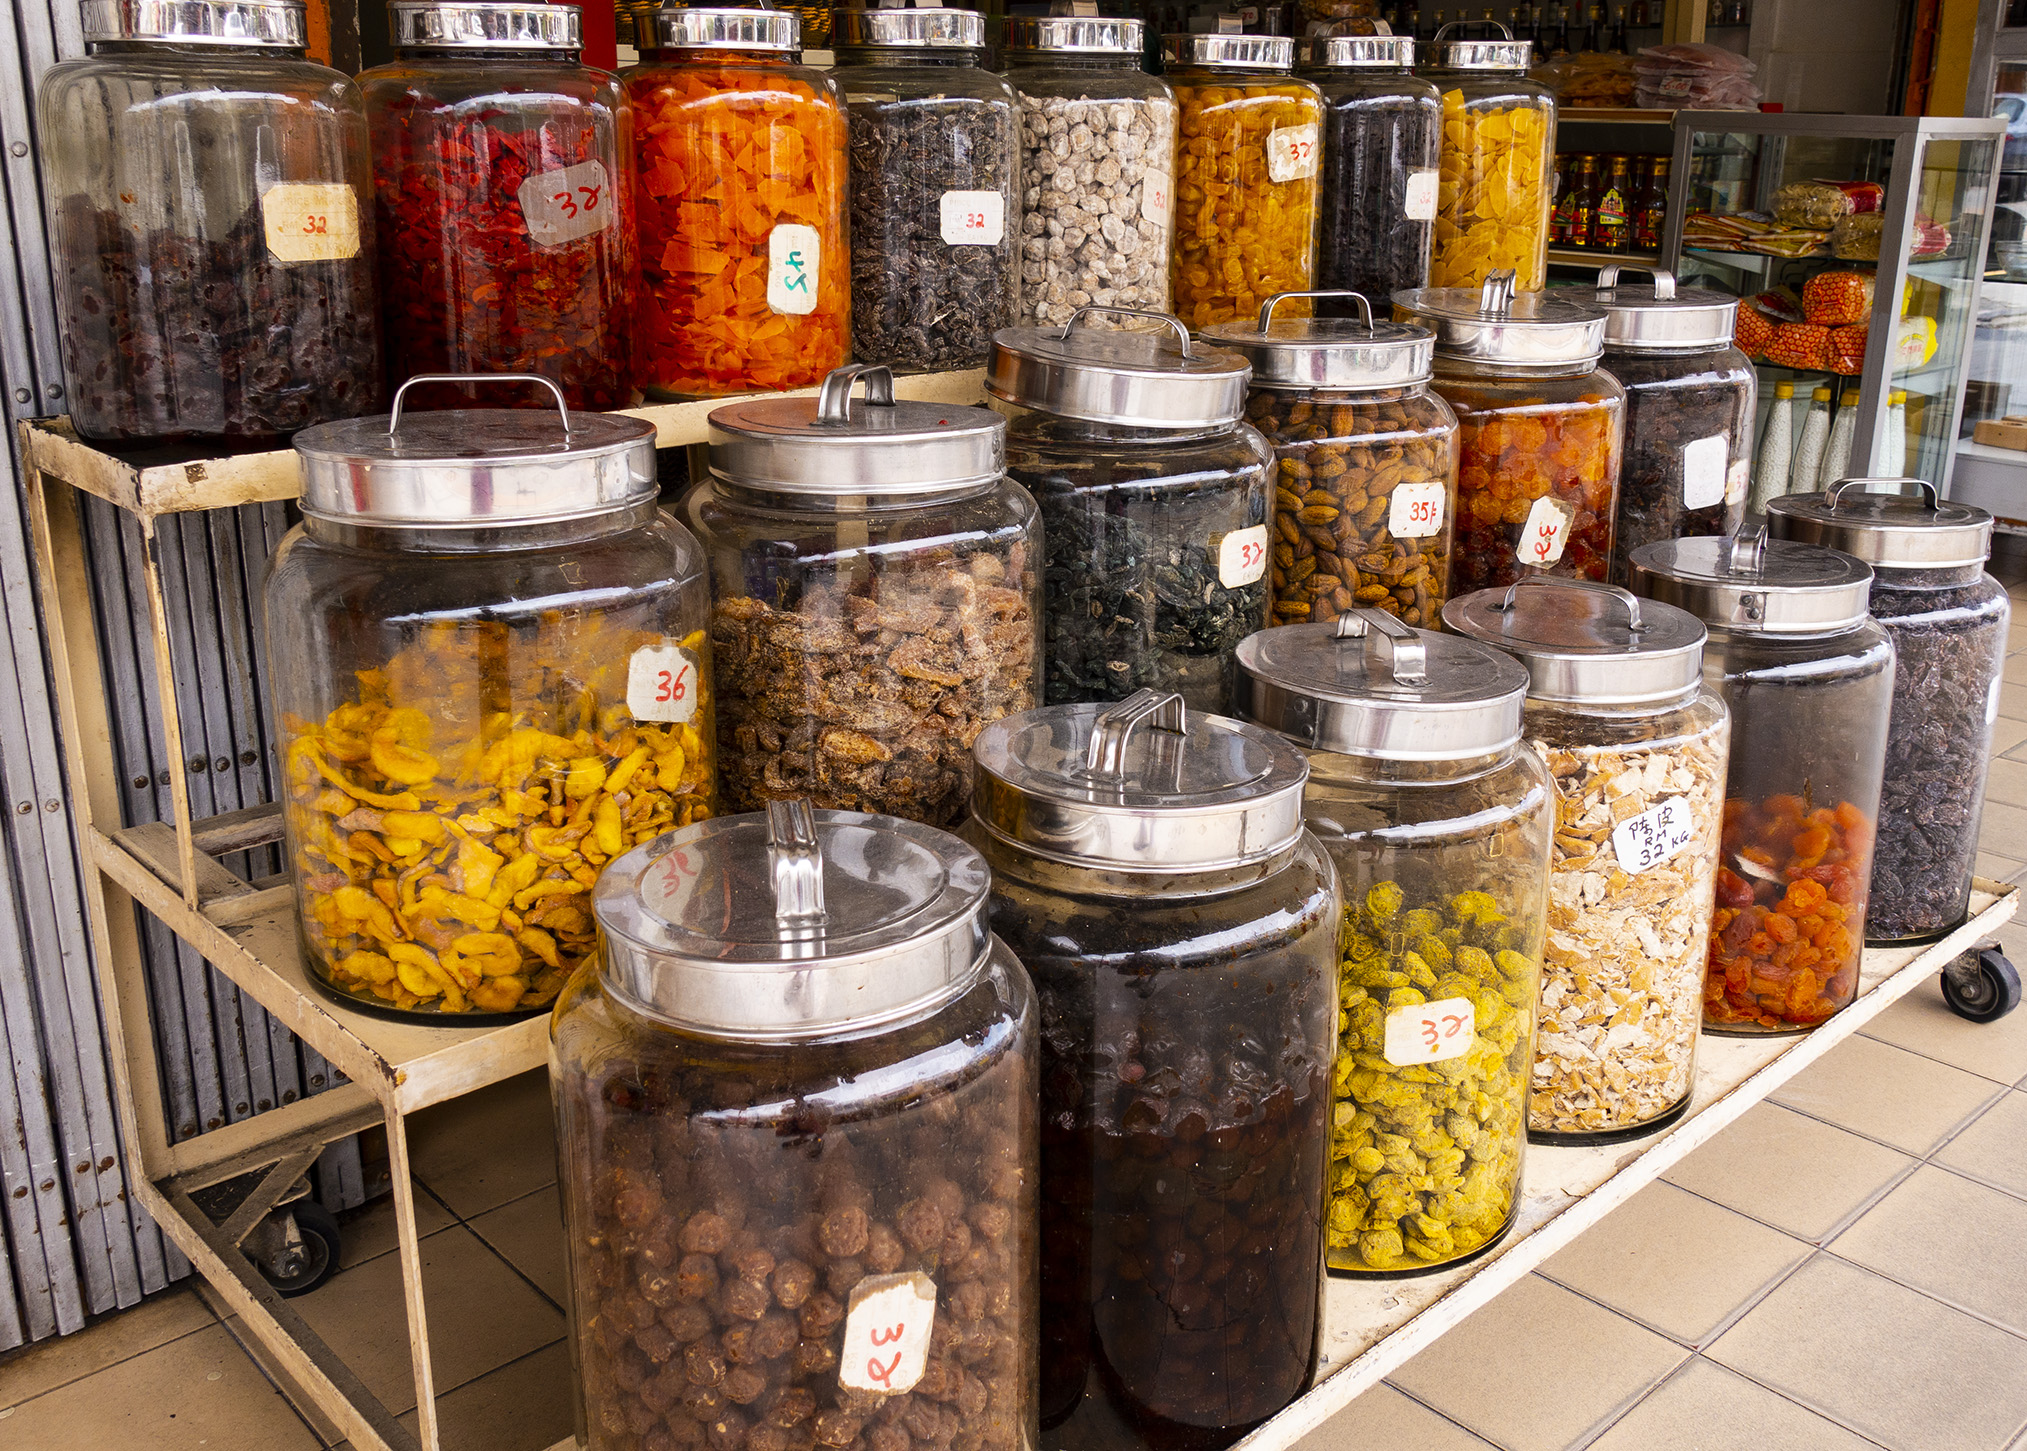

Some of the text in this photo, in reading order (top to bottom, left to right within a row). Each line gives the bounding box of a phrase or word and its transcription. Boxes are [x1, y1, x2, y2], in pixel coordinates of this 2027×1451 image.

[1290, 142, 1315, 160] 32
[553, 184, 601, 220] 32
[303, 215, 327, 234] 32
[965, 213, 985, 229] 32
[783, 250, 809, 295] 45
[1241, 541, 1264, 569] 32
[1535, 524, 1558, 560] 32
[656, 664, 689, 703] 36
[1639, 830, 1690, 866] 32 KG
[1644, 829, 1667, 847] RM
[1420, 1014, 1470, 1046] 32
[866, 1321, 906, 1389] 32
